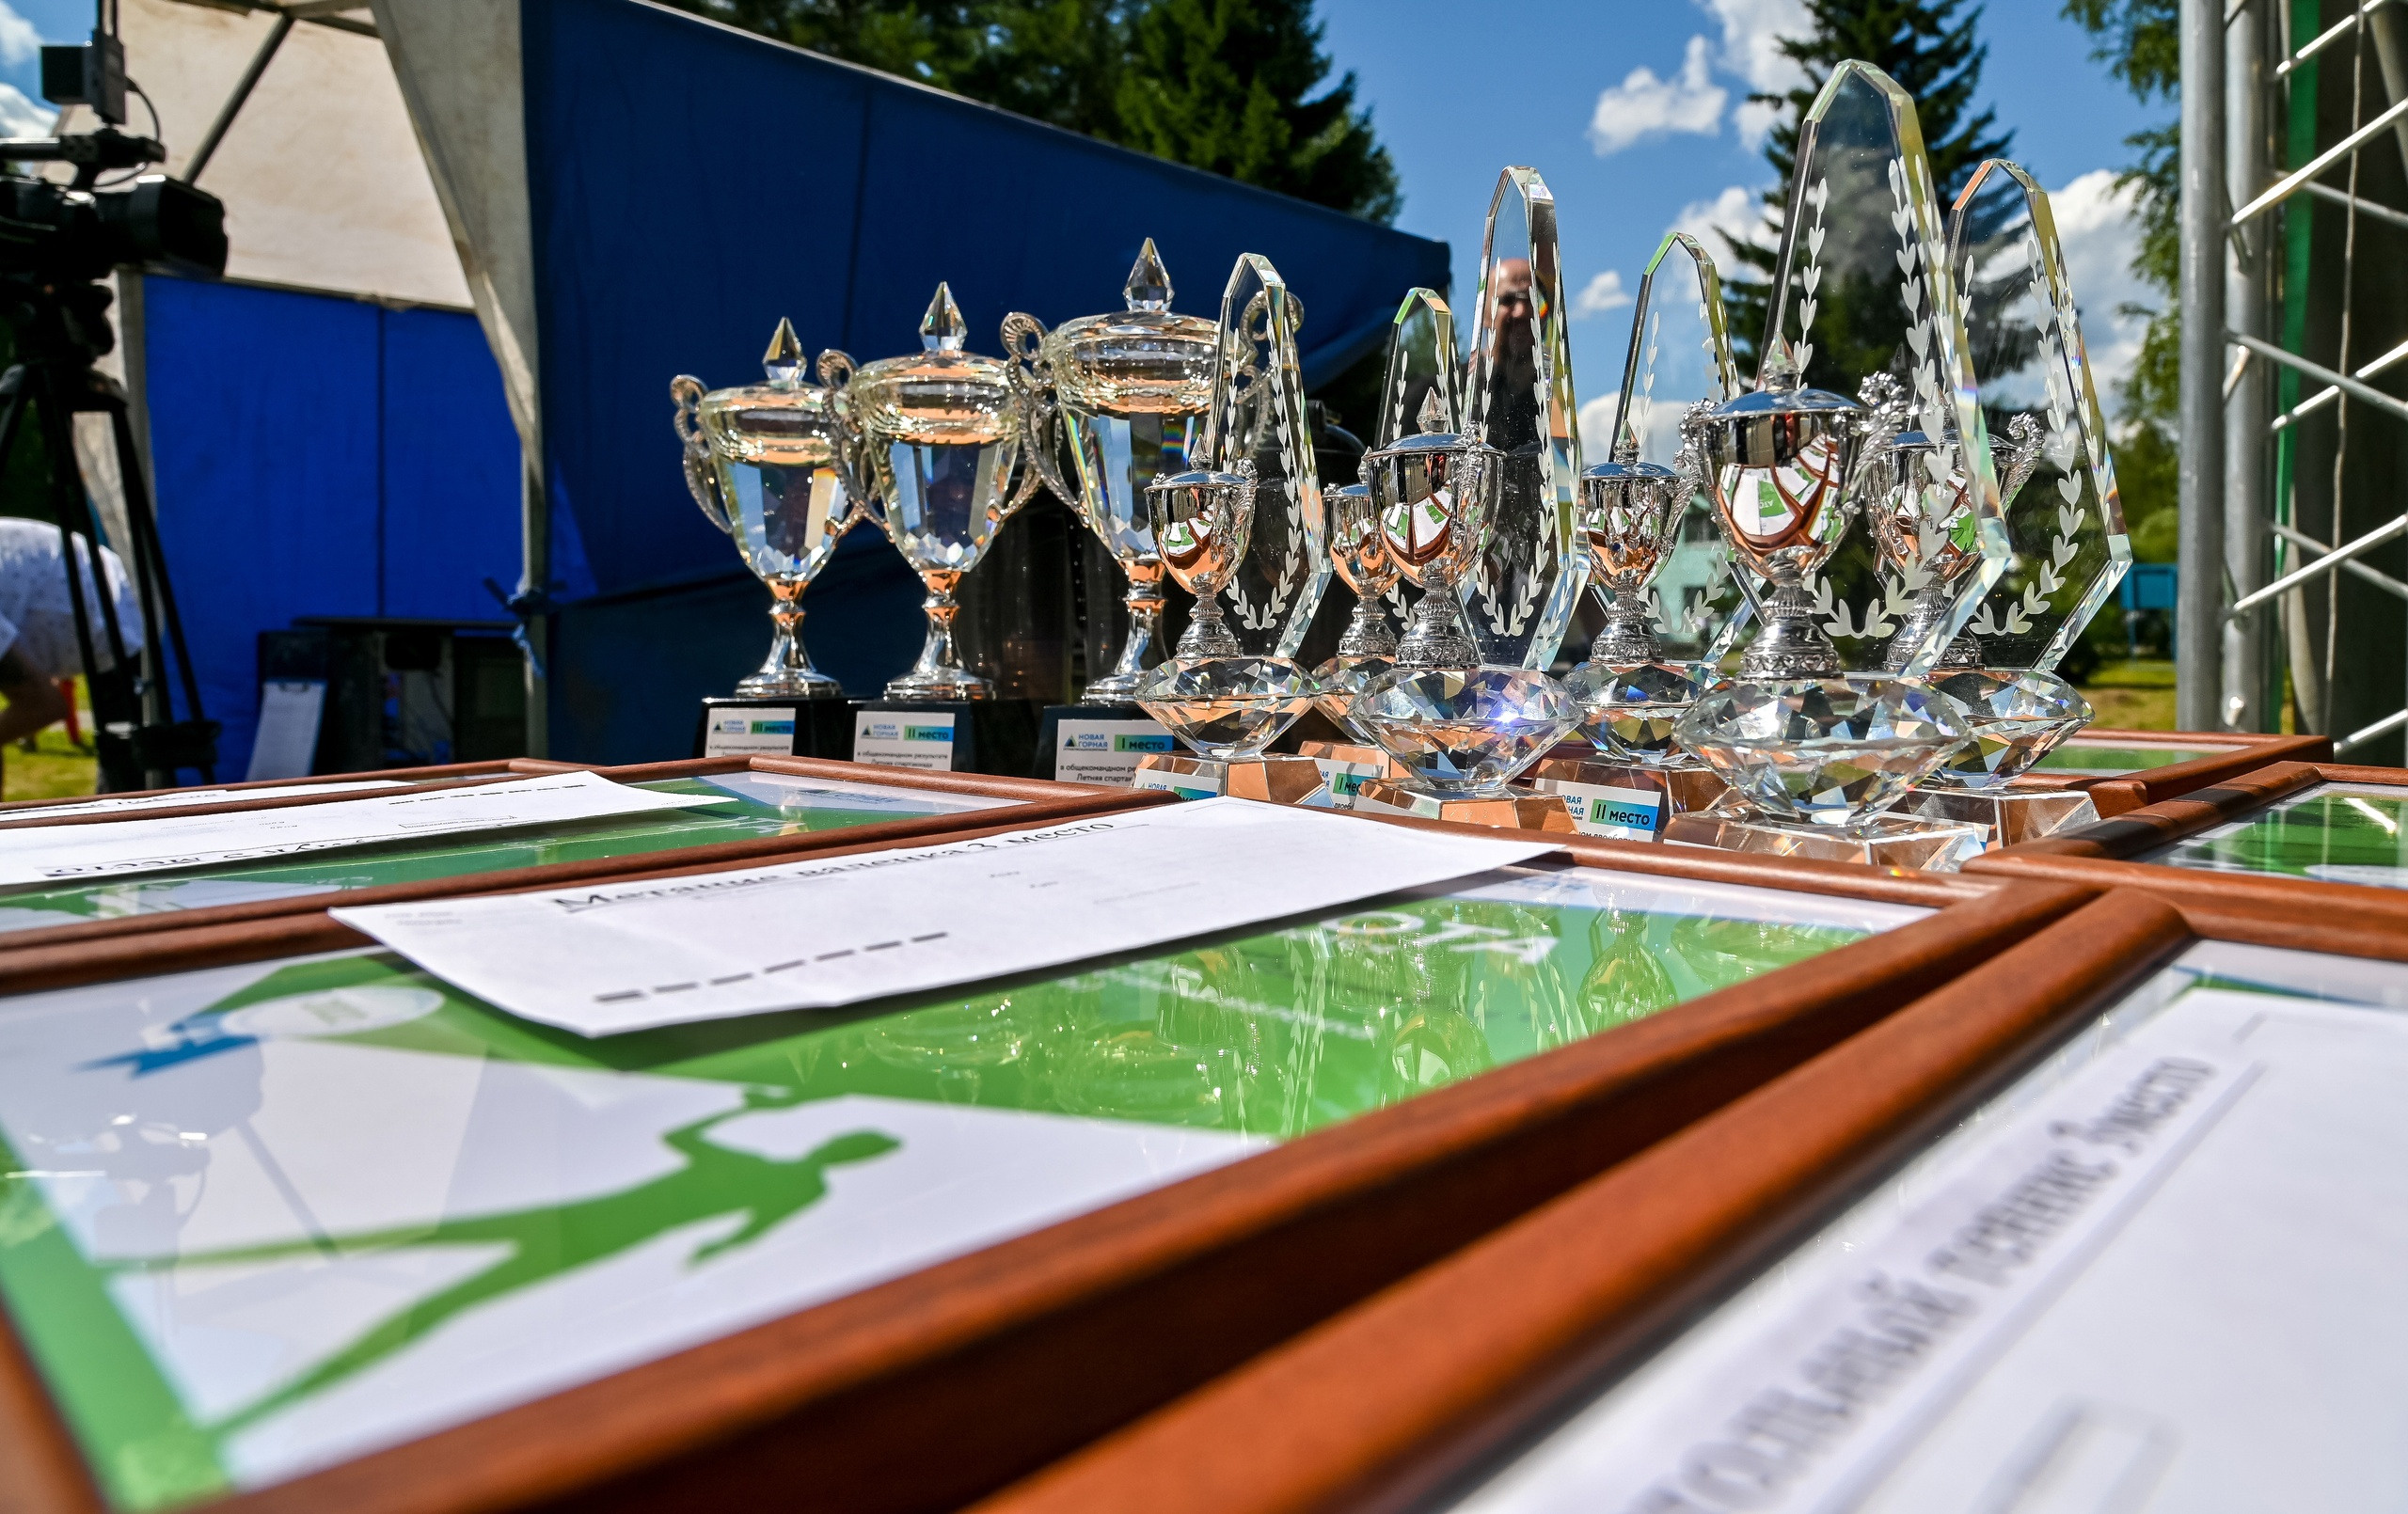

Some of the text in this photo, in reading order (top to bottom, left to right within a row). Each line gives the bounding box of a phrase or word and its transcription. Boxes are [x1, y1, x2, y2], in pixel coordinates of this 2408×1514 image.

[908, 727, 949, 740] II место
[1129, 740, 1165, 750] место
[1344, 781, 1361, 793] мес
[1595, 803, 1651, 826] II место
[1006, 823, 1115, 845] место
